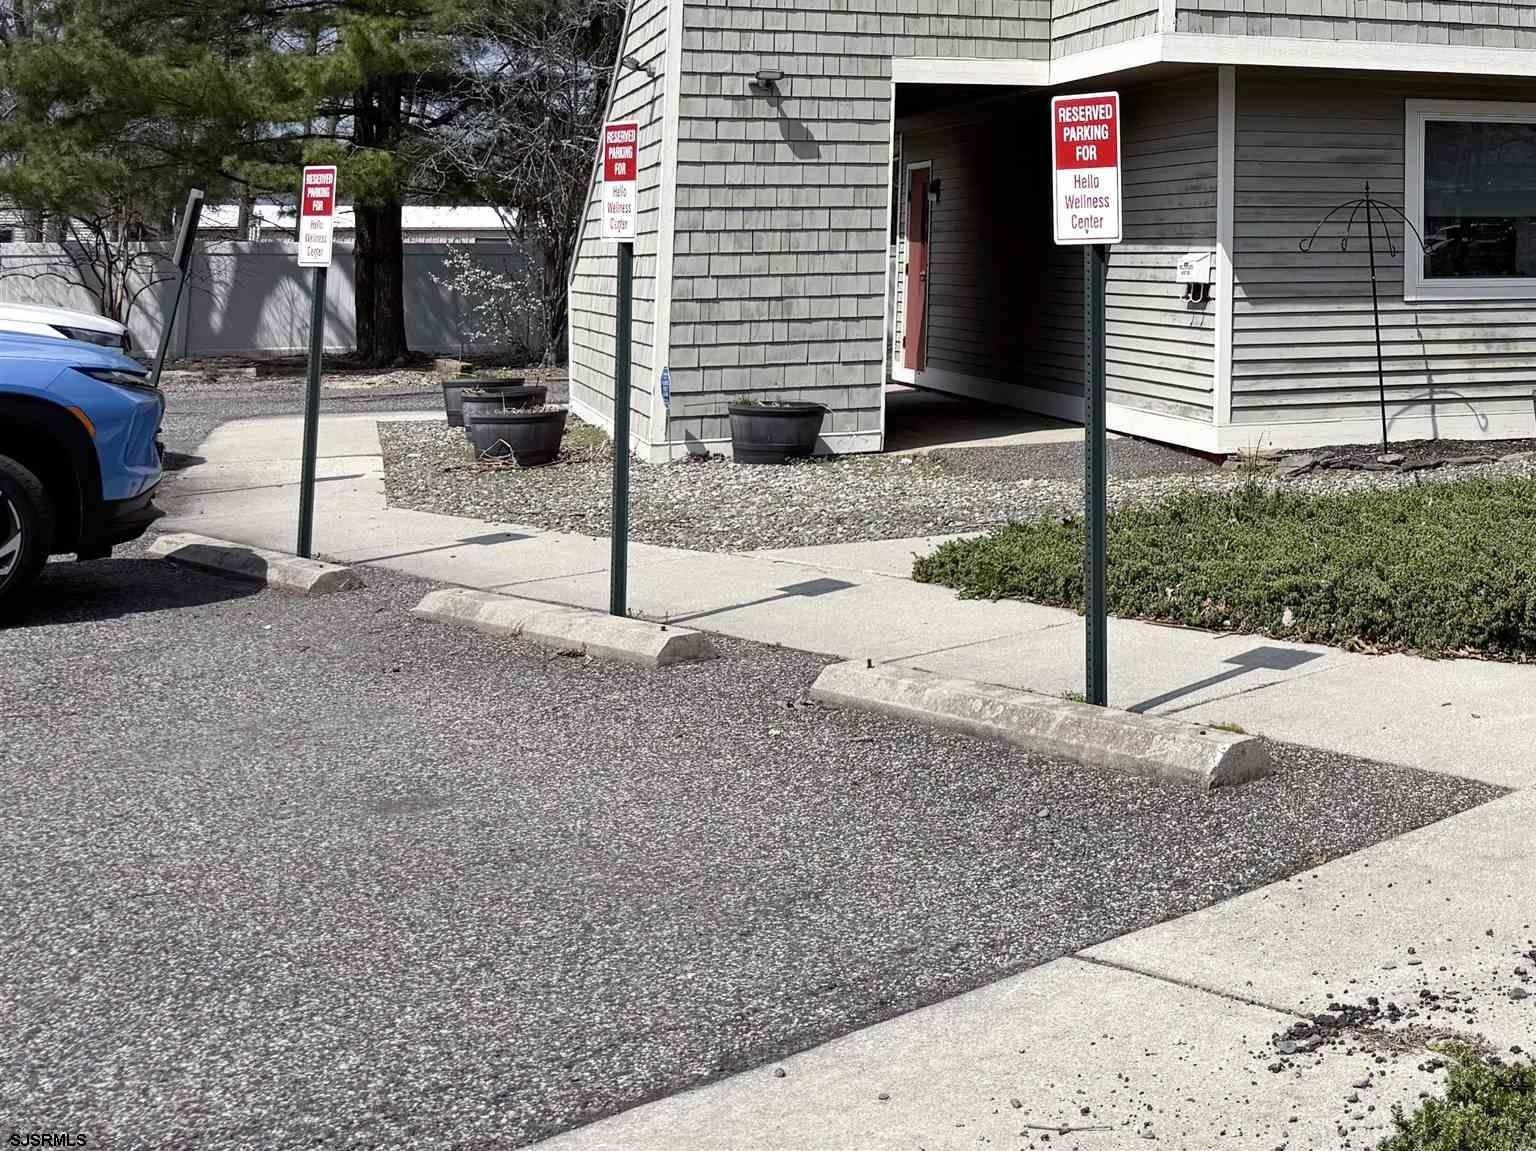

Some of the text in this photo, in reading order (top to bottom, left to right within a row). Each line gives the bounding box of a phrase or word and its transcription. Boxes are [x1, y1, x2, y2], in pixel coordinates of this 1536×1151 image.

[1058, 104, 1113, 122] RESERVED
[606, 129, 636, 144] RESERVED
[1063, 124, 1109, 142] PARKING
[608, 145, 633, 160] PARKING
[1075, 145, 1097, 161] FOR
[614, 162, 627, 176] FOR
[1074, 174, 1100, 189] Hello
[312, 199, 324, 212] FOR
[1064, 195, 1110, 209] Wellness
[1071, 214, 1104, 229] Center
